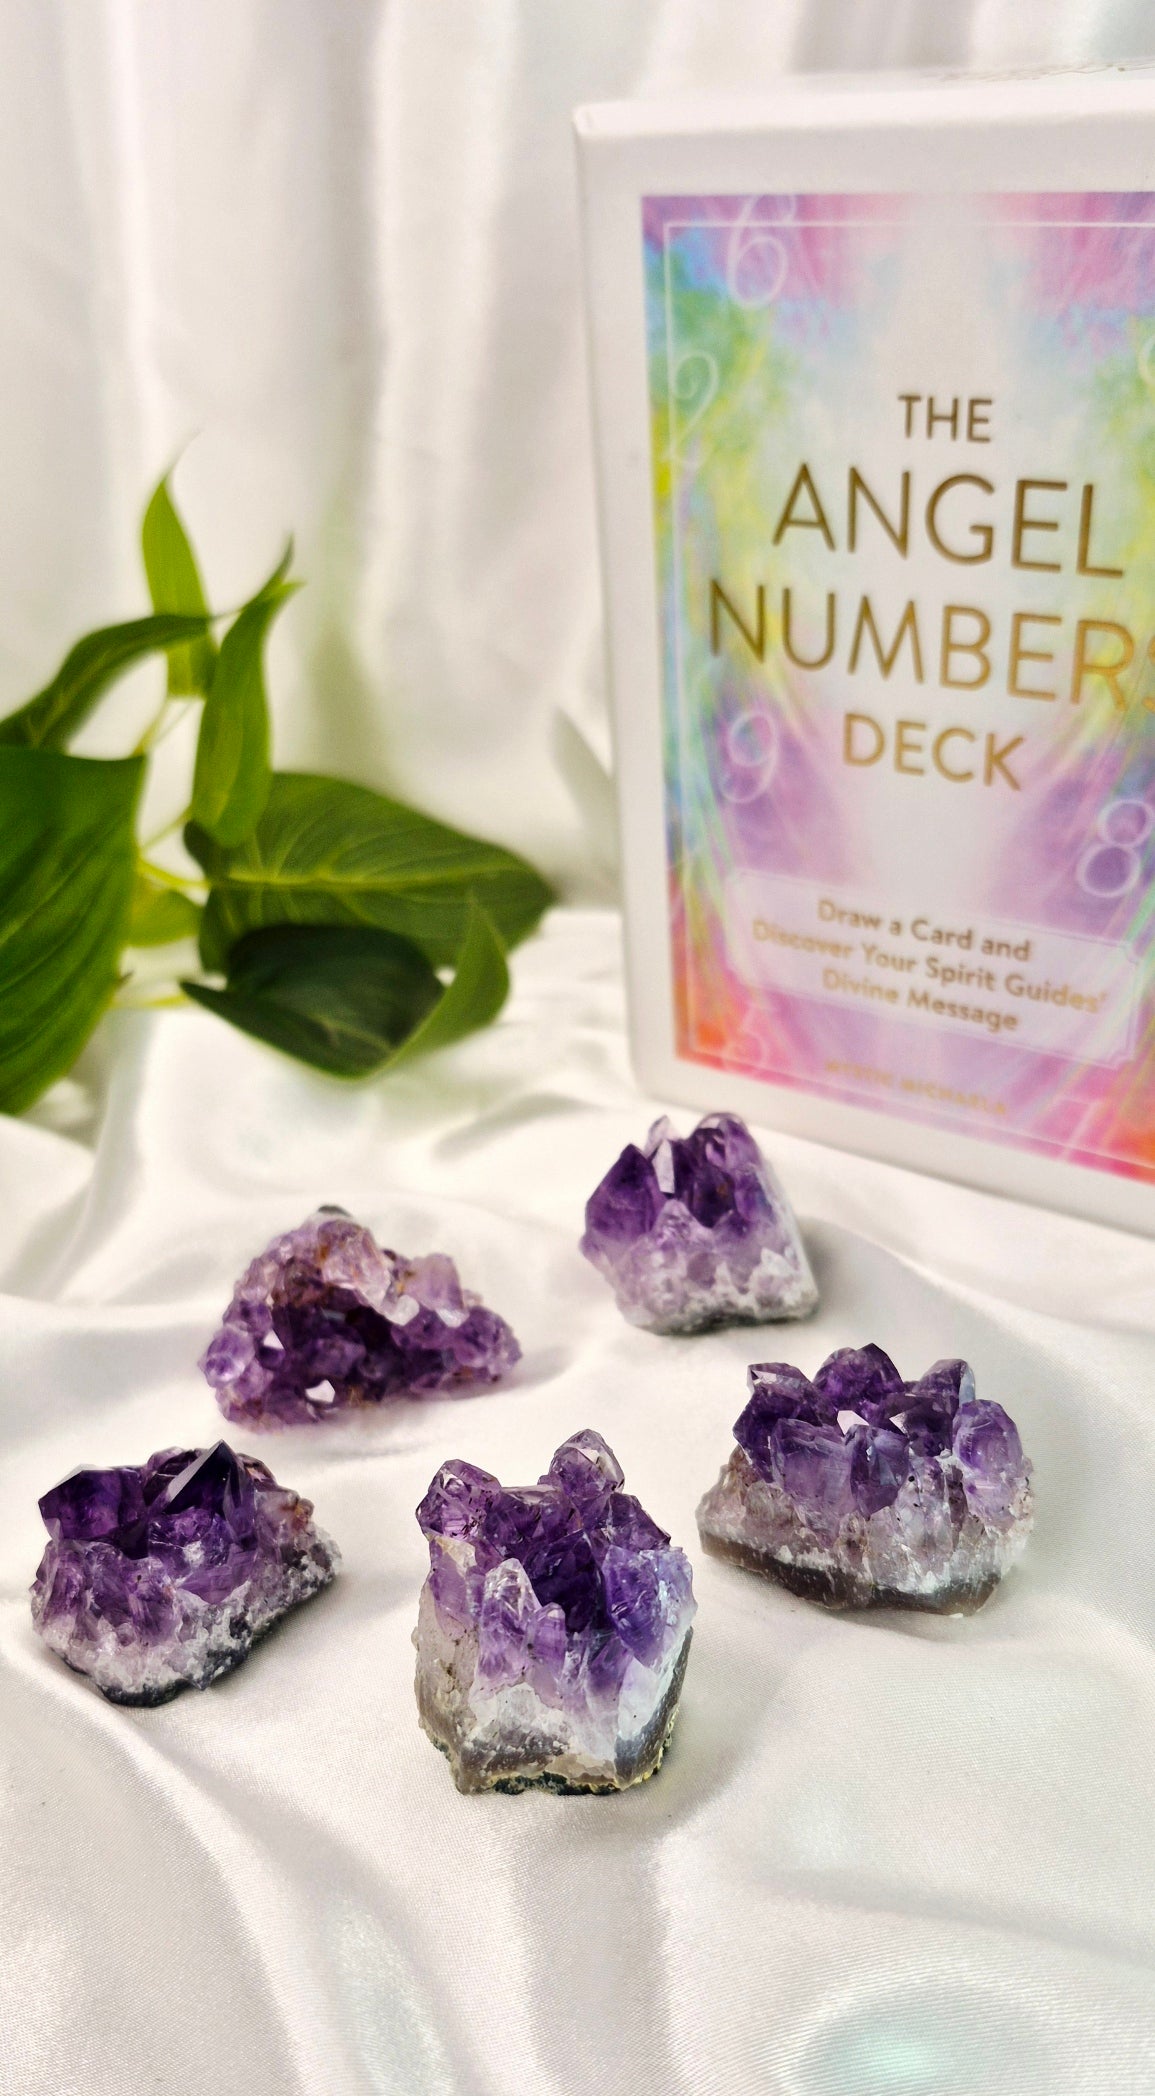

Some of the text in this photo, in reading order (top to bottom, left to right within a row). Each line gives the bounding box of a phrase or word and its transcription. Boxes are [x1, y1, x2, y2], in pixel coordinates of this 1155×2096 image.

[898, 395, 993, 443] THE
[772, 462, 1124, 579] ANGEL
[843, 712, 1025, 791] DECK
[752, 918, 854, 958] Discover
[861, 940, 917, 973] Your
[925, 955, 996, 992] Spirit
[817, 898, 1032, 962] Draw a Card and
[821, 966, 1020, 1034] Divine Message
